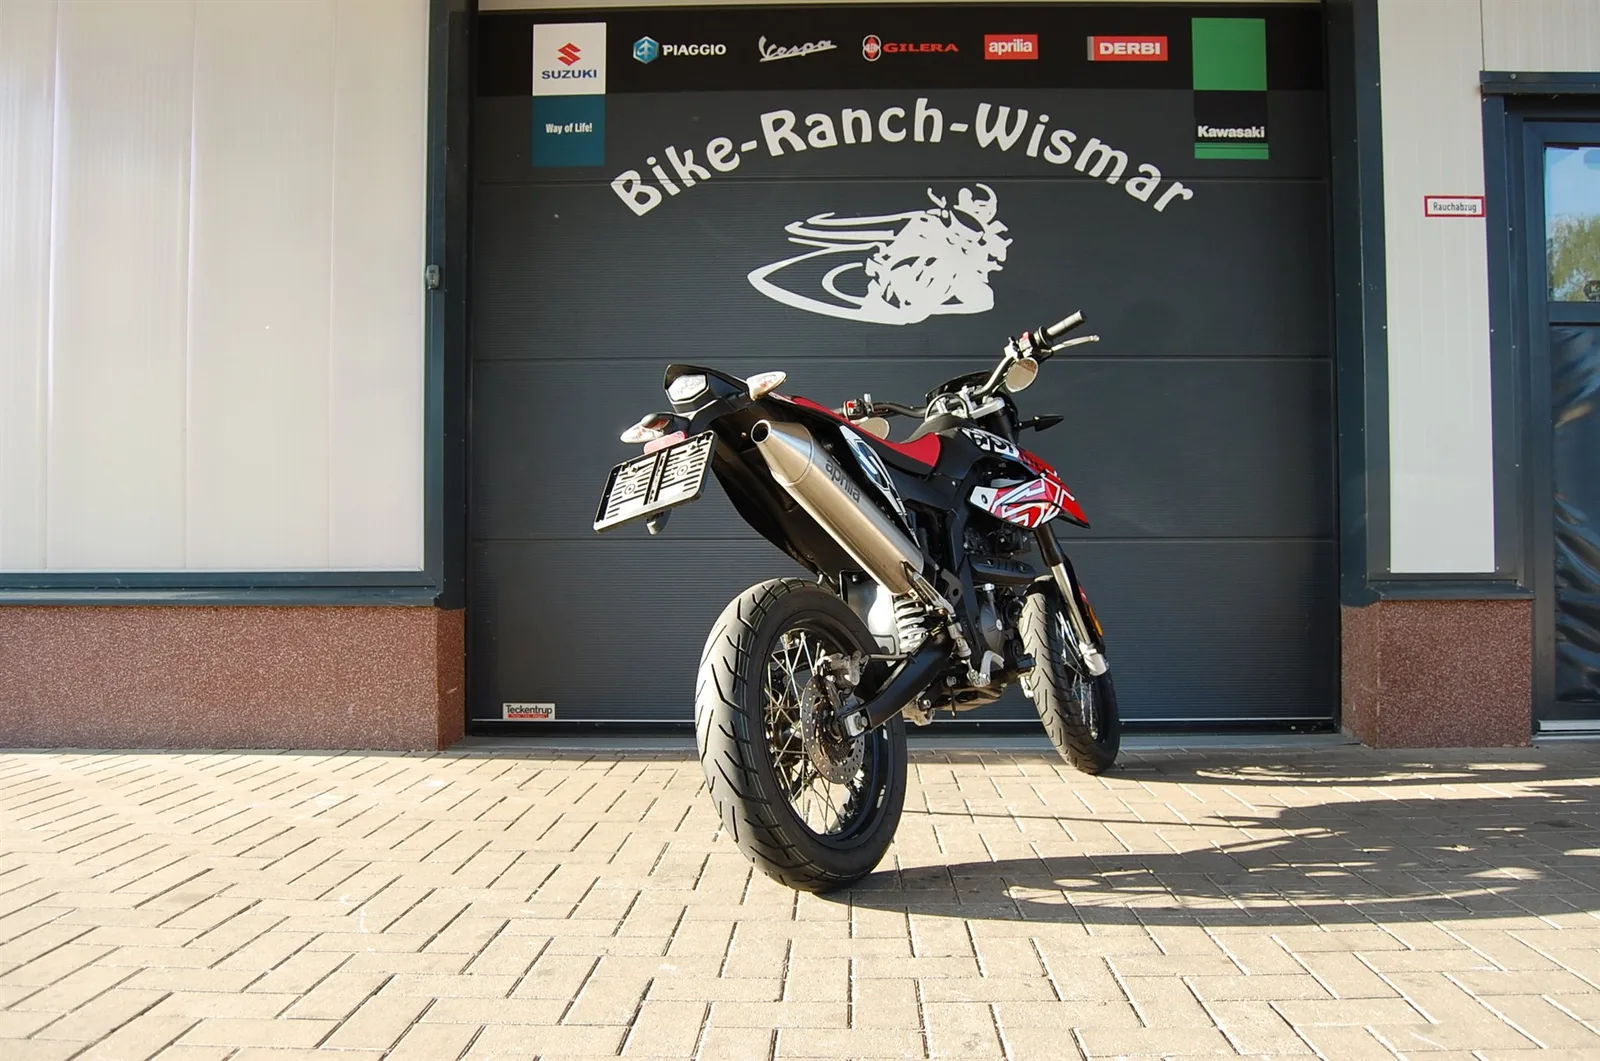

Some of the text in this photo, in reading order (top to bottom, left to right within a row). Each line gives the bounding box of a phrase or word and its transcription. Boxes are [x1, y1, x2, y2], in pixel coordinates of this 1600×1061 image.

[662, 44, 726, 57] PIAGGIO
[758, 35, 837, 62] Vespa
[883, 42, 959, 53] GILERA
[988, 38, 1033, 56] aprilia
[1099, 42, 1161, 55] DERBI
[541, 69, 597, 80] SUZUKI
[545, 122, 593, 135] Way of Life!
[1197, 125, 1265, 138] Kawasaki
[1433, 202, 1477, 213] Rauchabzug
[505, 704, 553, 715] Teckentrup
